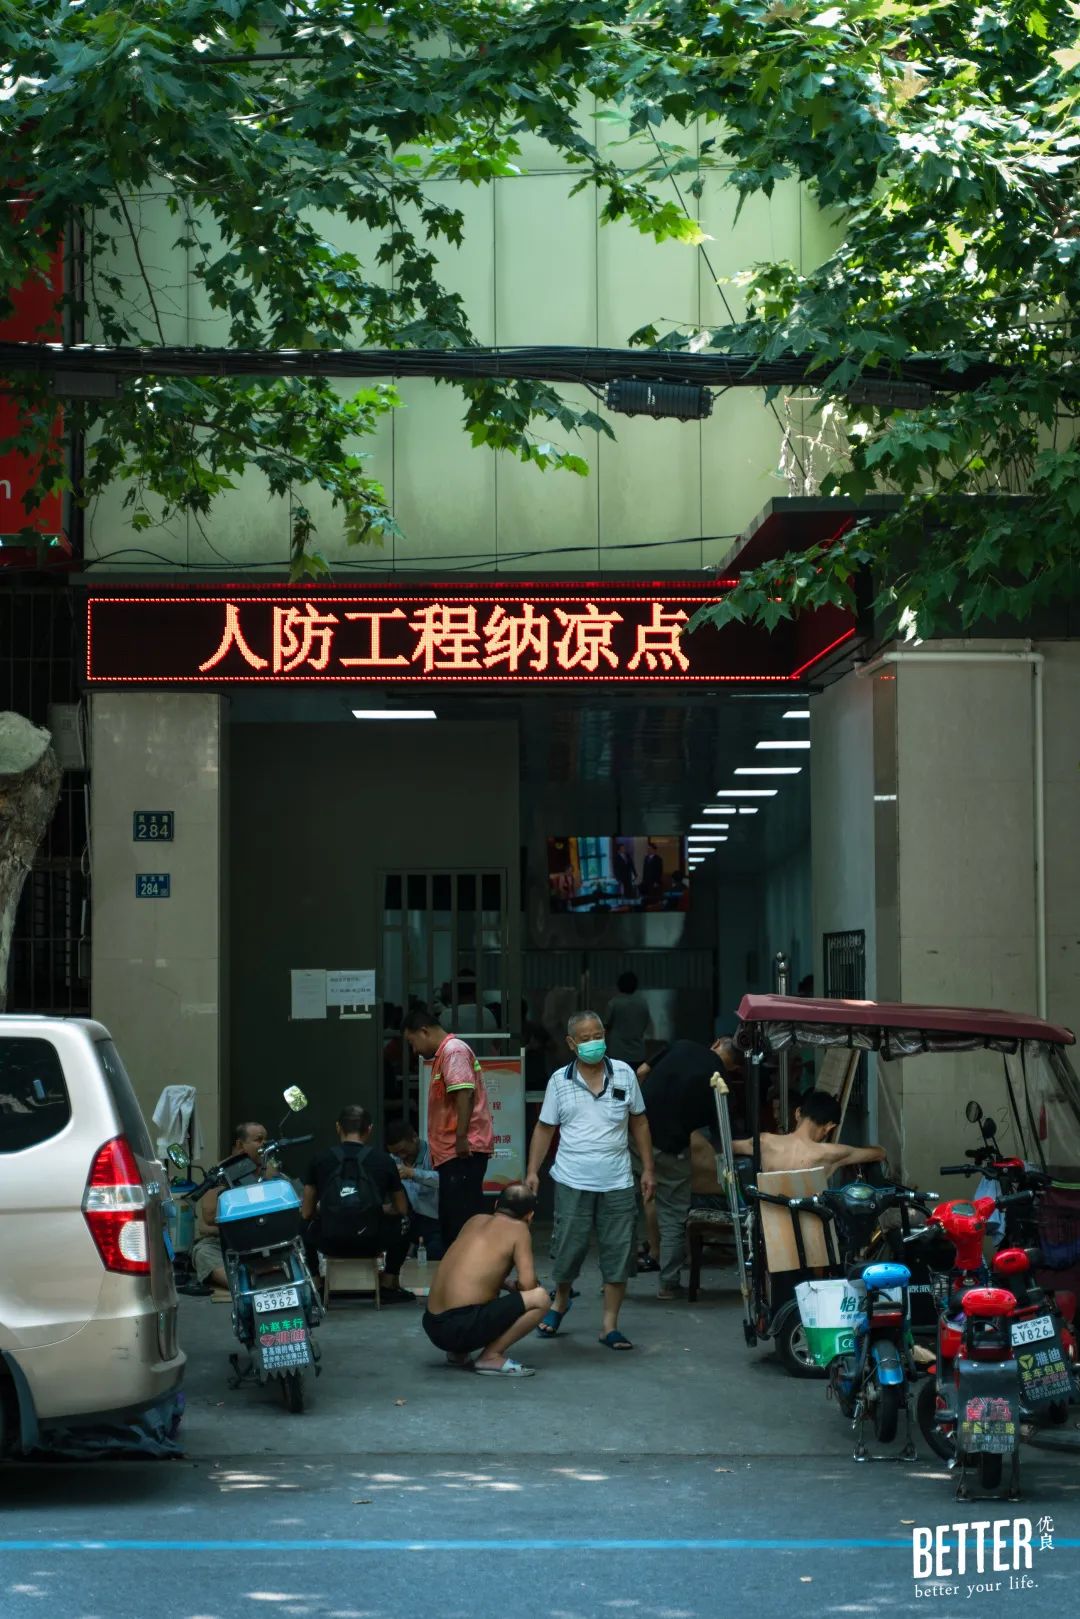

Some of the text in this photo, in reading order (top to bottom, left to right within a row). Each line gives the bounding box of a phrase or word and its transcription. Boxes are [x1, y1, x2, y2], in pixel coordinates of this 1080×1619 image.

[199, 602, 690, 673] 人防工程纳凉点
[138, 824, 168, 838] 284
[141, 883, 158, 895] 284
[256, 1296, 292, 1311] 95962
[1012, 1325, 1049, 1345] EV826
[1035, 1348, 1061, 1367] 雅迪
